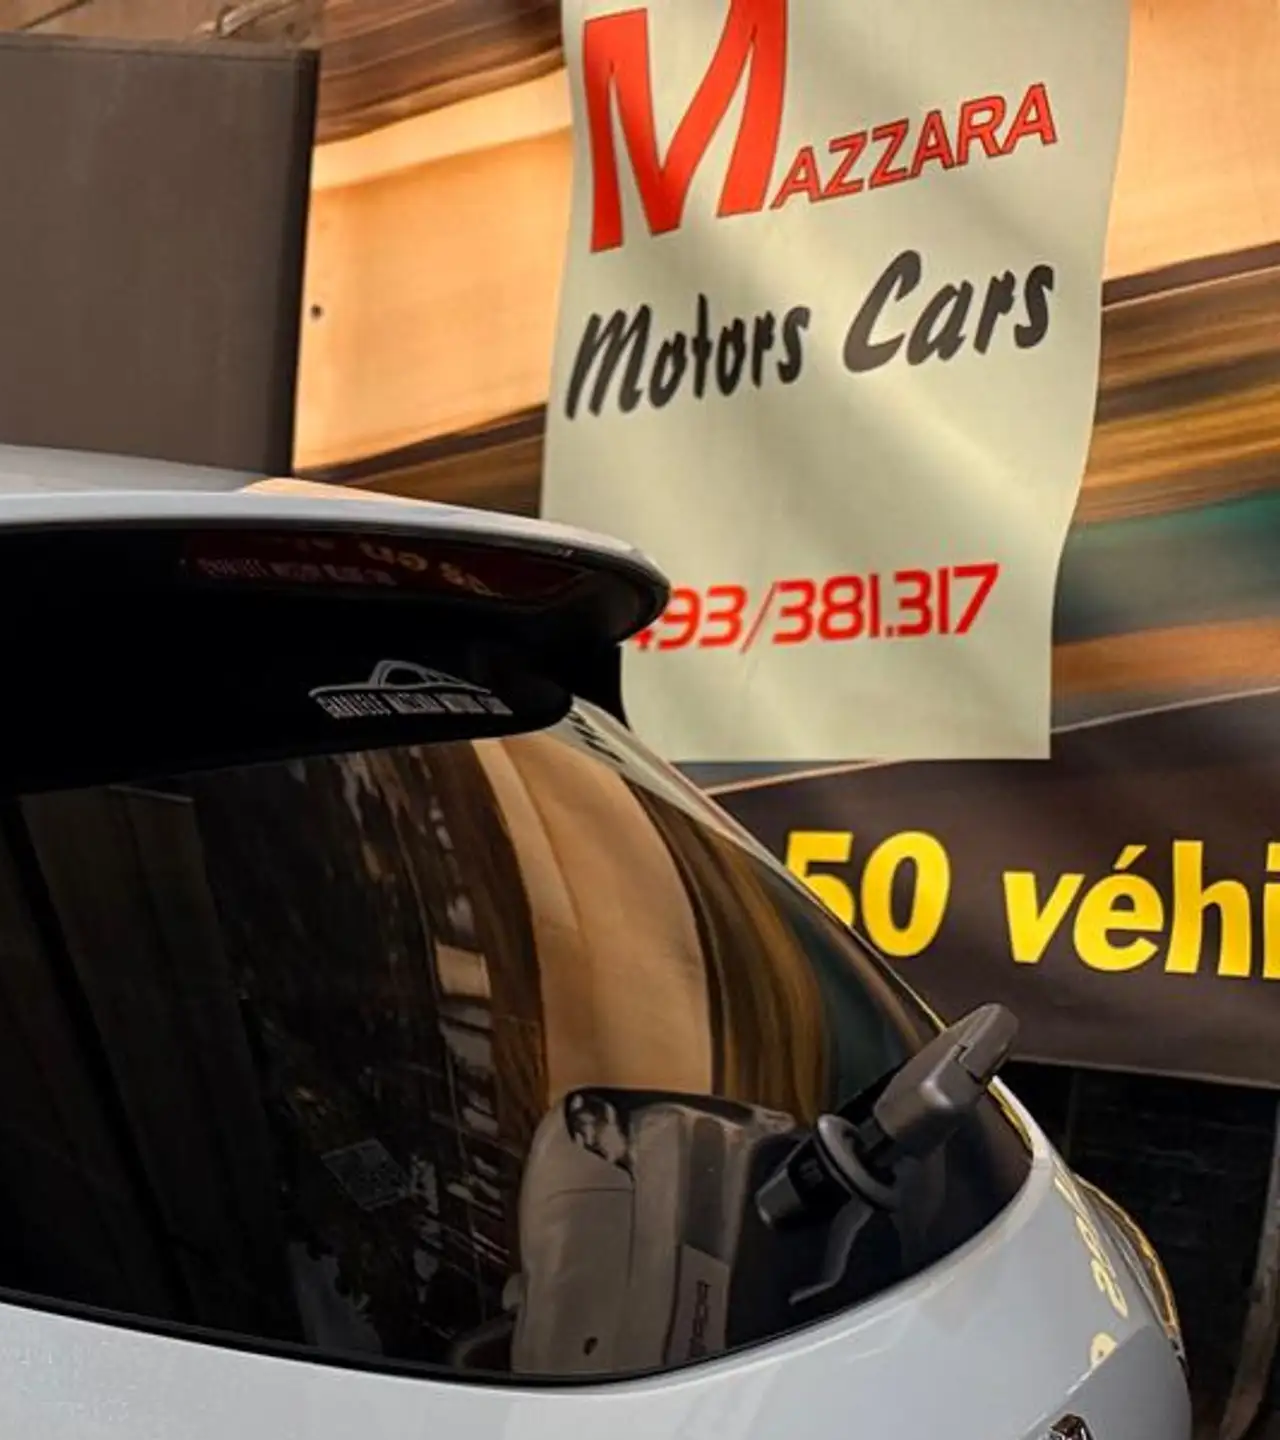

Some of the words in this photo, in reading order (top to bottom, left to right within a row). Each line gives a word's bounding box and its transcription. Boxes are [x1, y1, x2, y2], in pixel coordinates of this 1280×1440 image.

[583, 0, 1057, 253] MAZZARA
[565, 293, 810, 420] Motors
[843, 249, 1054, 374] Cars
[633, 563, 1000, 654] 93/381.317
[1003, 840, 1280, 981] véhi
